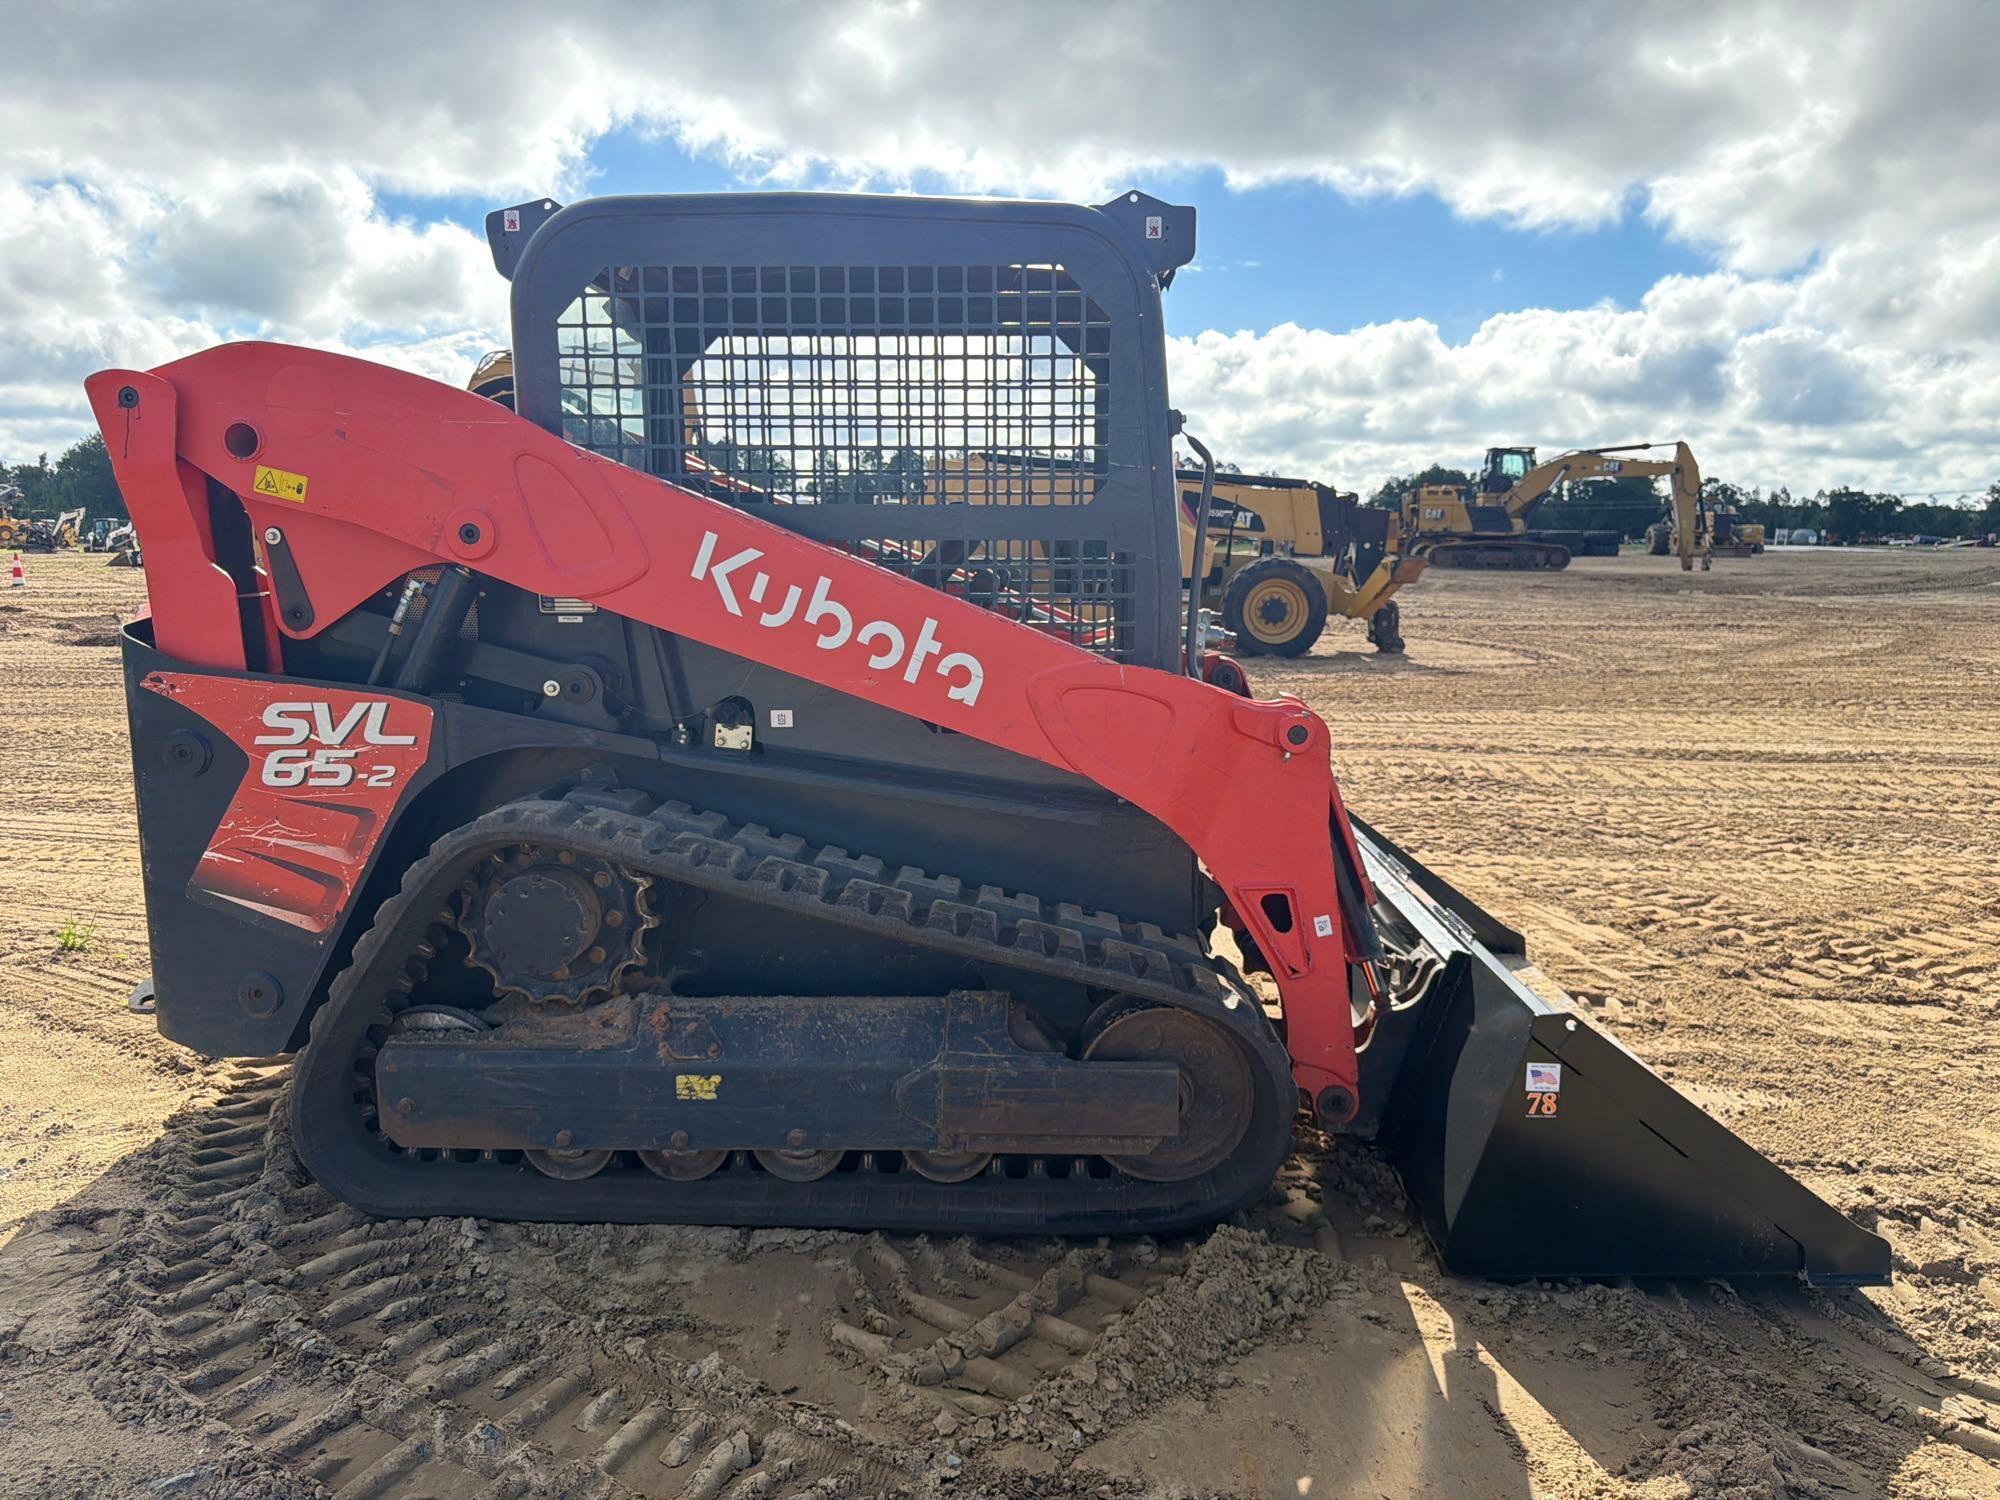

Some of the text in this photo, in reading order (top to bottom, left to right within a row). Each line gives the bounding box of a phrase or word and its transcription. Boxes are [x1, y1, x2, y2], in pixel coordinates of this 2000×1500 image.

[1603, 461, 1619, 472] CAT
[1224, 510, 1254, 529] AT
[1425, 508, 1442, 520] CAT
[690, 530, 984, 707] Kubota
[254, 702, 417, 745] SVL
[261, 749, 397, 787] 65-2
[1526, 1092, 1557, 1115] 78
